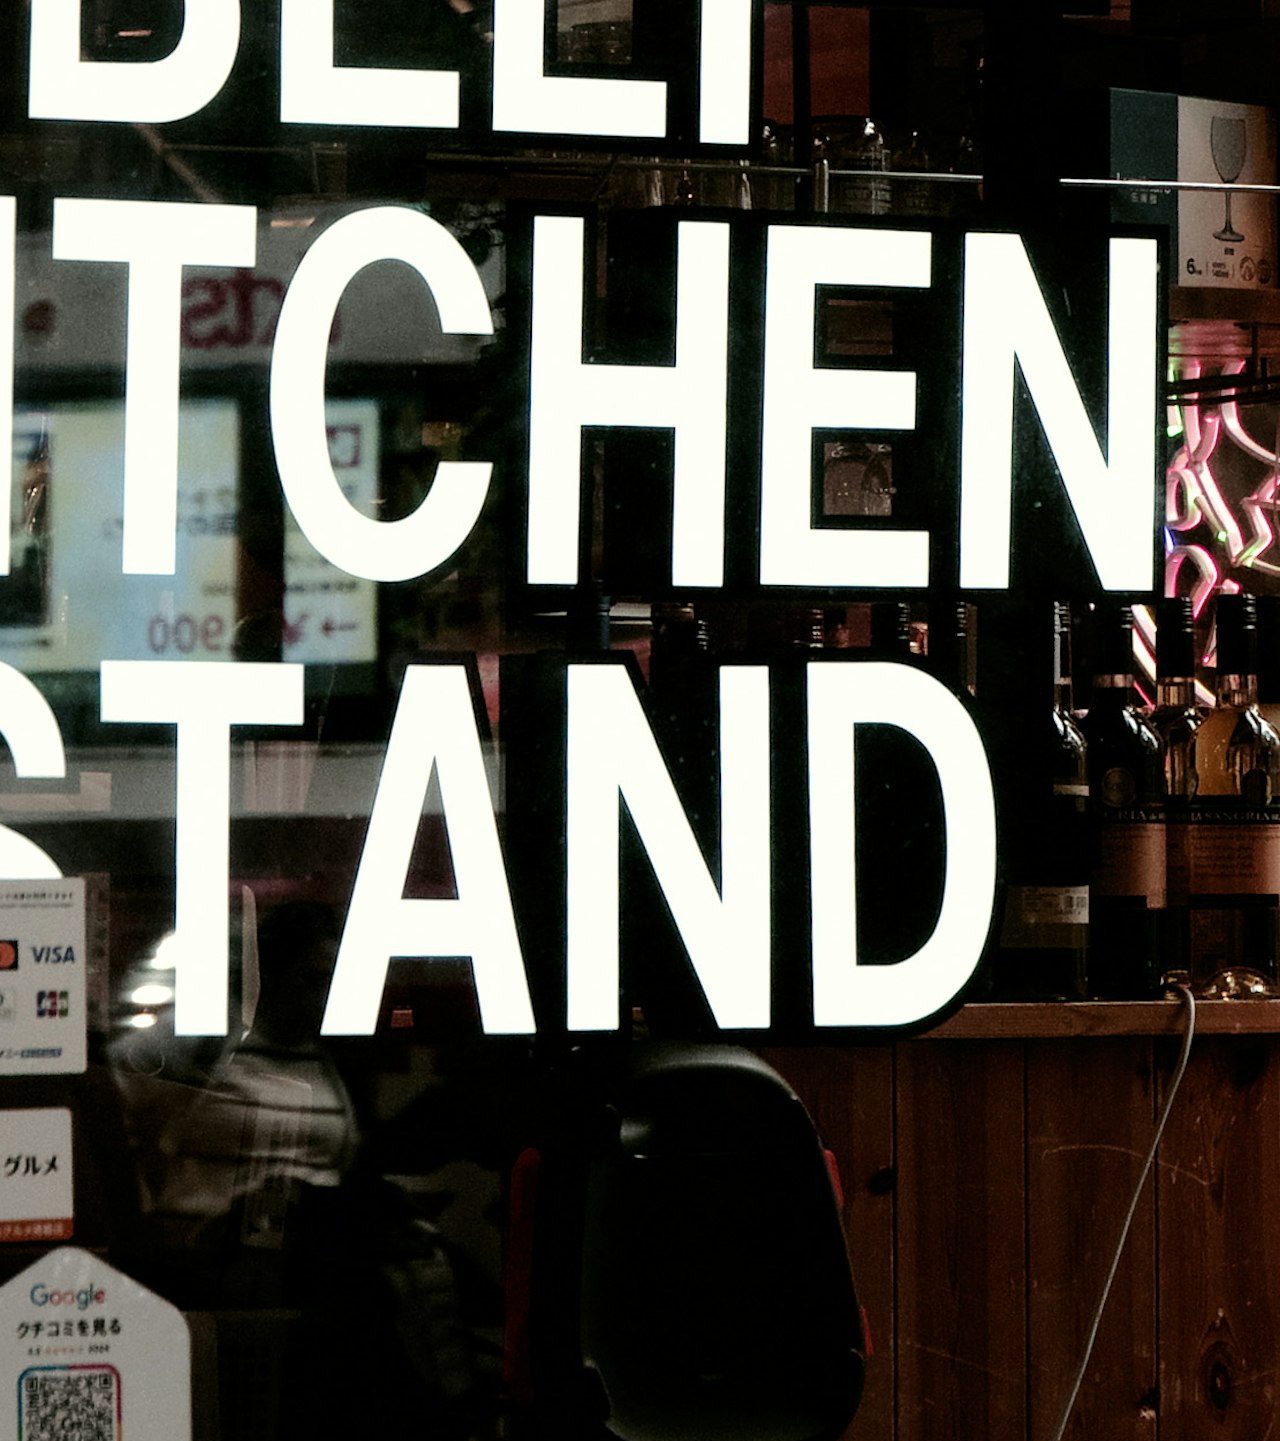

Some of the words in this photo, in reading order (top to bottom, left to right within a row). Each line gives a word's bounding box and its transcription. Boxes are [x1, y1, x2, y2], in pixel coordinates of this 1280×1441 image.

[31, 945, 76, 964] VISA
[4, 1154, 59, 1177] グルメ
[30, 1282, 106, 1311] Google
[17, 1318, 122, 1340] クチコミを見る
